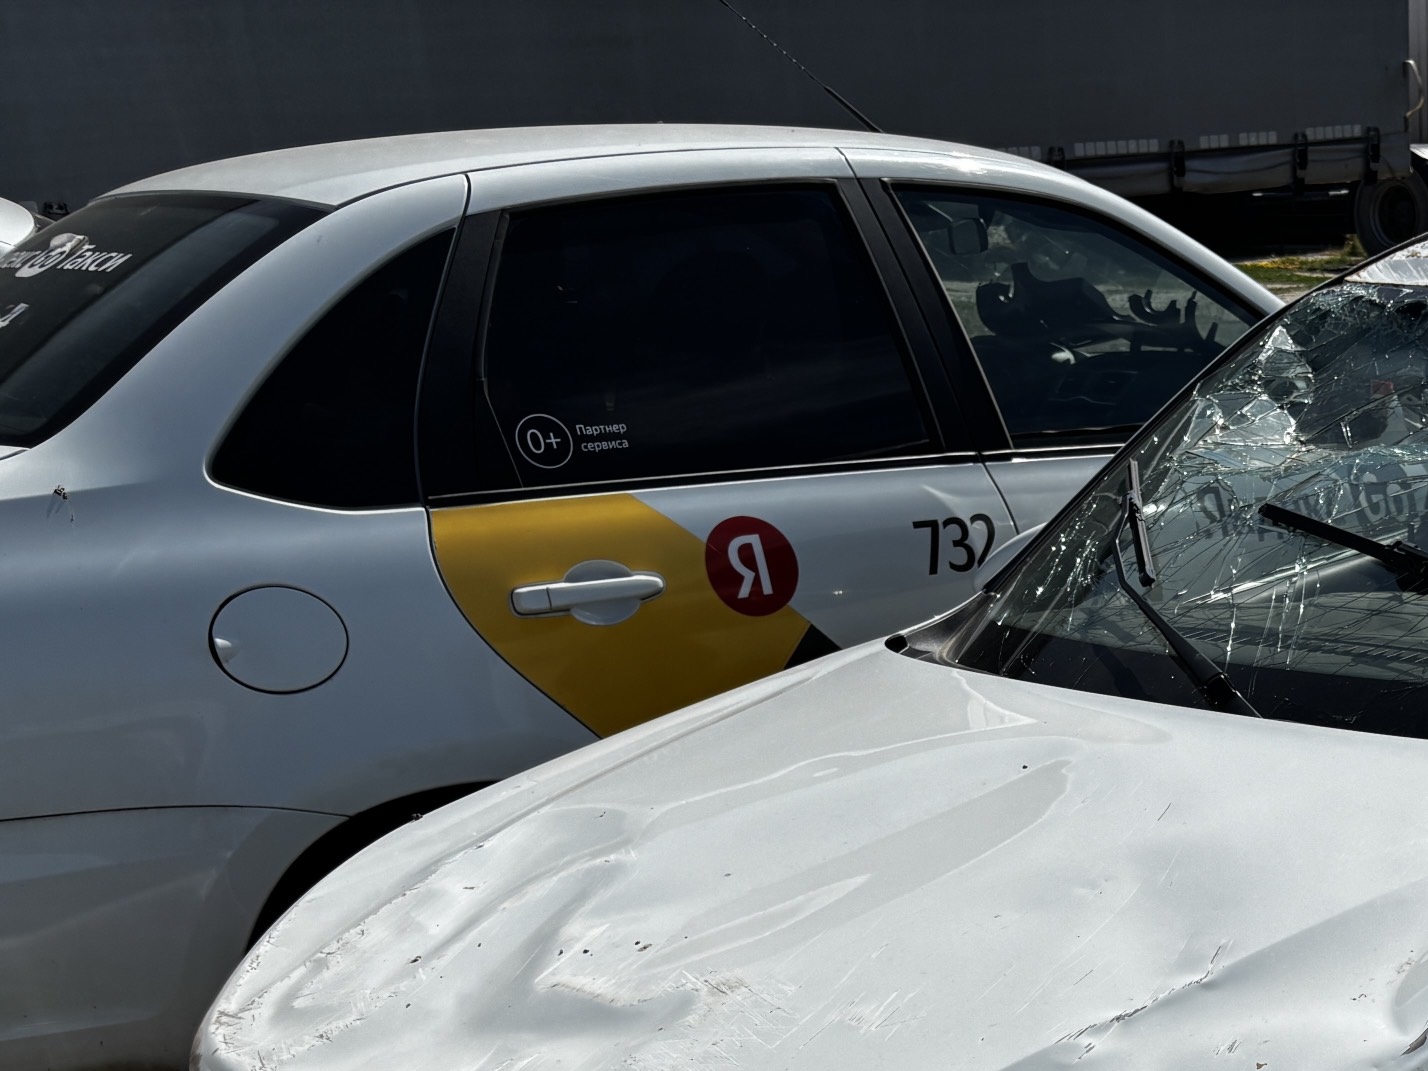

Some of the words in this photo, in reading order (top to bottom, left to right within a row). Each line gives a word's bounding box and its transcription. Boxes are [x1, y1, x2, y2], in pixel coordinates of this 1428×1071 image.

[56, 244, 133, 272] Такси
[526, 428, 562, 454] 0+
[575, 422, 628, 437] Партнер
[581, 438, 630, 453] сервиса
[912, 513, 995, 576] 732
[727, 533, 775, 599] Я
